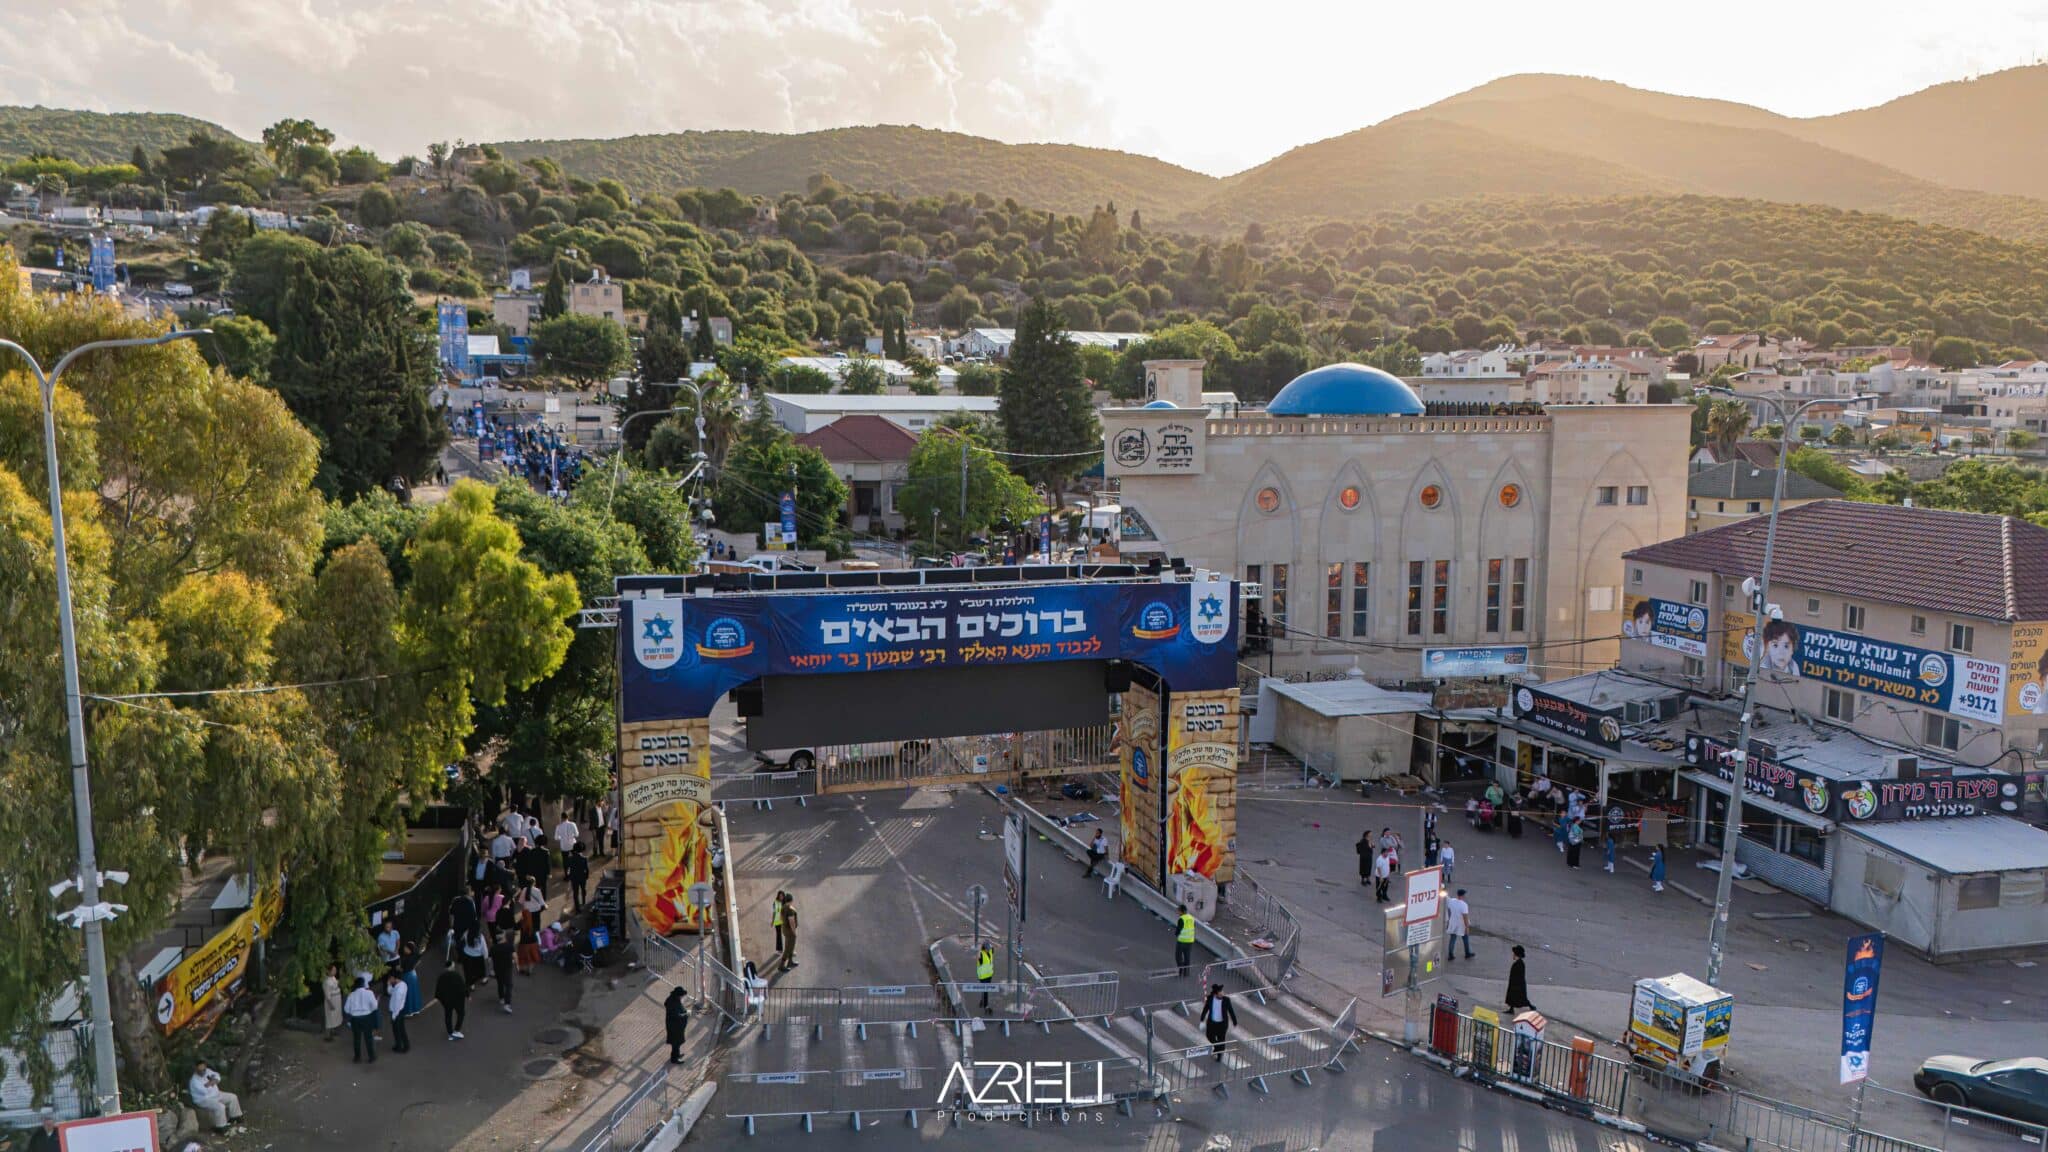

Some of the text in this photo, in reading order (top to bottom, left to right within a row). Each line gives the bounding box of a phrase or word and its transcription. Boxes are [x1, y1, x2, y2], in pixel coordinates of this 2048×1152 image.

[1163, 434, 1187, 445] בית
[891, 601, 928, 611] בעומר
[995, 596, 1035, 607] הילולת
[820, 608, 1087, 645] ברוכים הבאים
[1803, 631, 1917, 665] יד עזרא ושולמית
[1803, 645, 1912, 679] Yad Ezra Ve'Shulamit
[1966, 660, 2000, 674] תורמים
[1802, 660, 1940, 703] לא משאירים ילד רעב!
[1970, 671, 2000, 684] ורואים
[1966, 681, 1999, 694] ישועות
[1186, 703, 1225, 717] ברוכים
[1187, 719, 1223, 732] הבאים
[641, 735, 691, 750] ברוכים
[643, 752, 689, 767] הבאים
[1761, 760, 1795, 789] פיצה
[1881, 777, 1998, 806] פיצה הר מירון
[1905, 803, 1975, 817] פיצוצייה
[1410, 889, 1437, 904] כניסה
